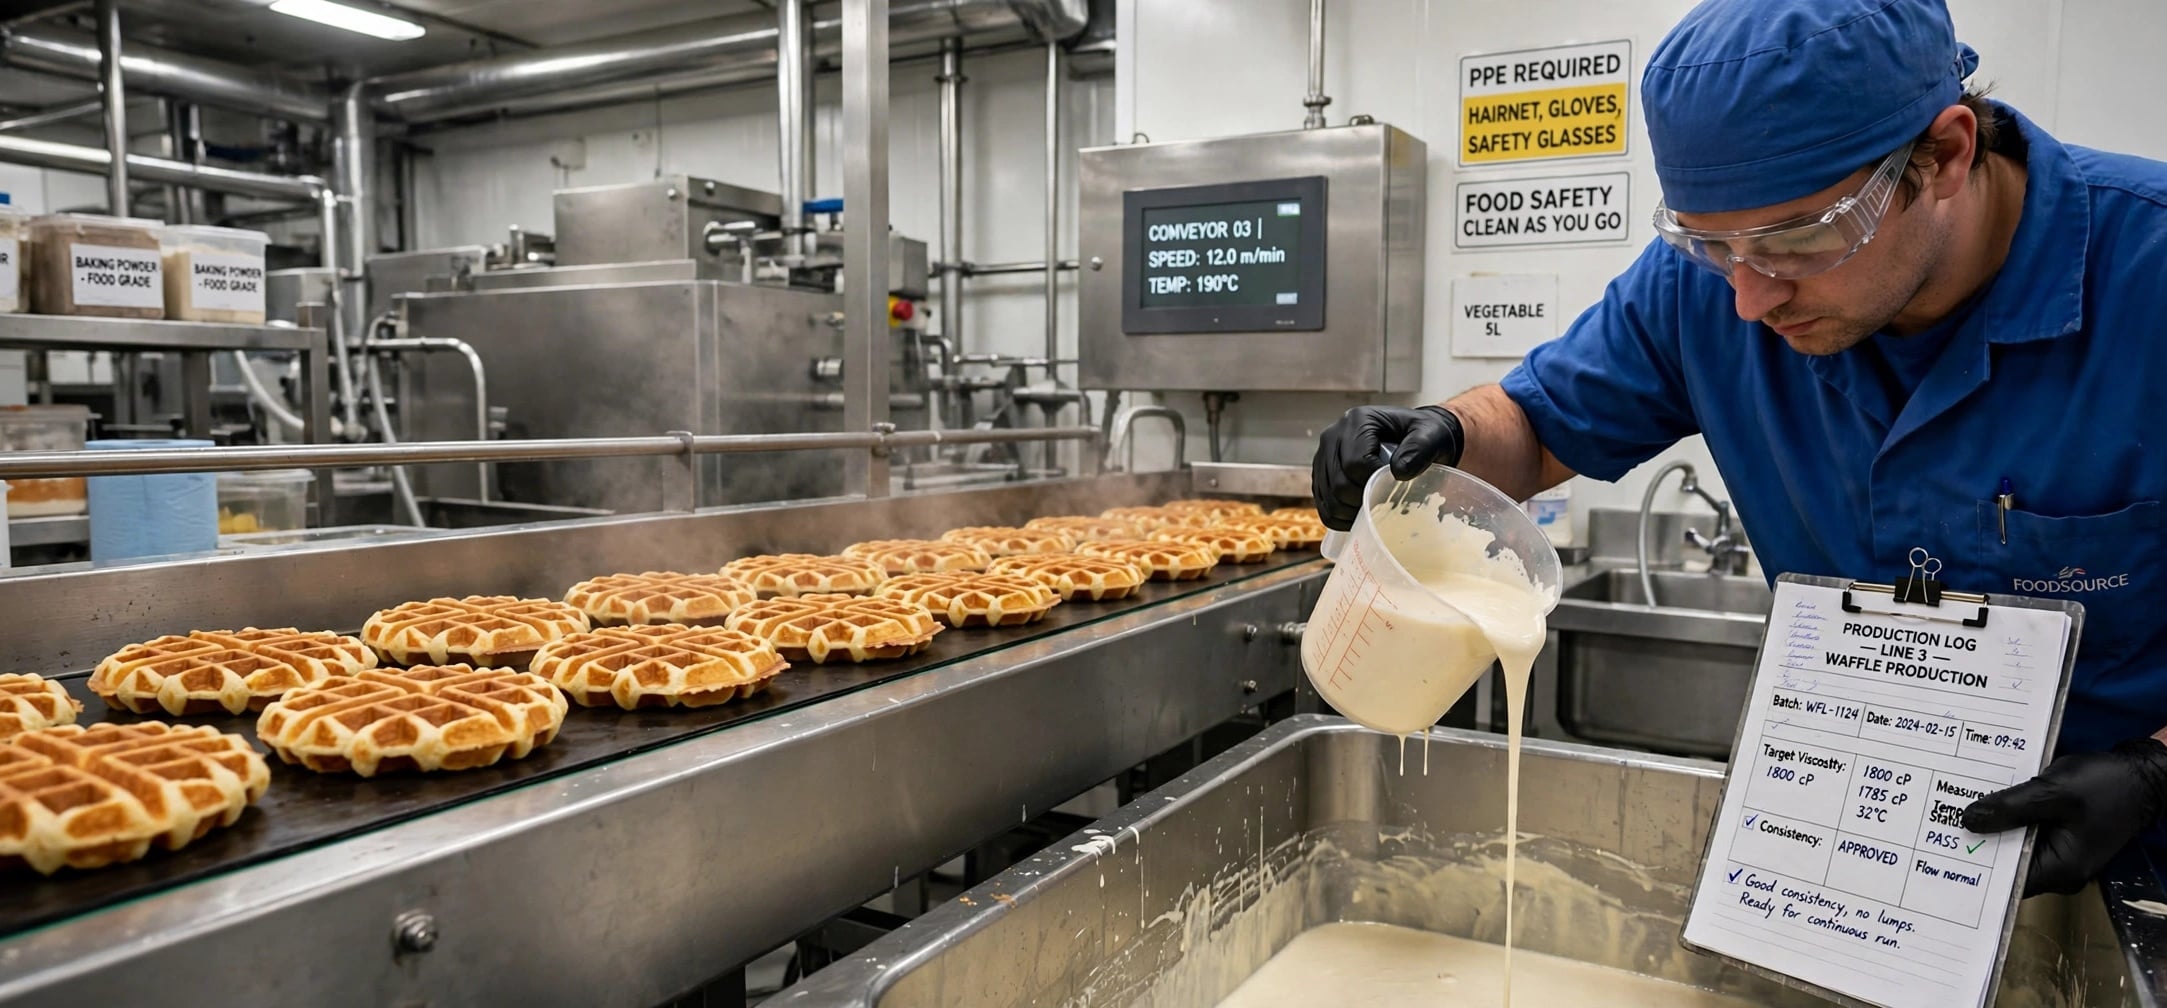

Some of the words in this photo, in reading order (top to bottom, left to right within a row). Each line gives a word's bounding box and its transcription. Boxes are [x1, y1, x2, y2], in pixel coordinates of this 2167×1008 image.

[1469, 65, 1506, 88] PPE
[1514, 54, 1621, 82] REQUIRED
[1468, 101, 1543, 125] HAIRNET,
[1549, 94, 1622, 119] GLOVES,
[1468, 131, 1532, 154] SAFETY
[1537, 125, 1616, 149] GLASSES
[1466, 192, 1524, 214] FOOD
[1530, 185, 1613, 210] SAFETY
[1149, 221, 1228, 242] CONVEYOR
[1233, 220, 1251, 238] 03
[1464, 216, 1519, 236] CLEAN
[1524, 215, 1547, 234] AS
[1552, 213, 1589, 232] YOU
[1595, 212, 1621, 230] GO
[76, 256, 115, 271] BAKING
[117, 258, 158, 273] POWDER
[1149, 250, 1200, 268] SPEED:
[1206, 248, 1236, 265] 12.0
[1240, 246, 1285, 264] m/min
[88, 272, 115, 286] FOOD
[118, 274, 152, 288] GRADE
[195, 263, 227, 277] BAKING
[204, 278, 227, 290] FOOD
[1149, 276, 1191, 294] TEMP:
[1197, 274, 1239, 293] 190°C
[1464, 304, 1544, 319] VEGETABLE
[1485, 322, 1501, 336] 5L
[2013, 573, 2130, 593] FOODSOURCE
[1843, 622, 1941, 647] PRODUCTION
[1944, 635, 1977, 651] LOG
[1880, 644, 1914, 660] LINE
[1917, 649, 1927, 662] 3
[1825, 651, 1882, 672] WAFFLE
[1885, 661, 1988, 688] PRODUCTION
[1773, 694, 1802, 711] Batch:
[1805, 700, 1859, 720] WFL-1124
[1866, 711, 1893, 727] Date:
[1894, 717, 1957, 738] 2024-02-15
[1965, 729, 1992, 745] Time:
[1994, 734, 2026, 750] 09:42
[1764, 743, 1796, 762] Target
[1767, 765, 1795, 782] 1800
[1798, 773, 1815, 786] cP
[1863, 765, 1893, 782] 1800
[1895, 773, 1912, 786] cP
[1858, 785, 1889, 802] 1785
[1891, 793, 1908, 806] cP
[1936, 780, 1994, 801] Measure
[1856, 805, 1888, 823] 32°C
[1760, 820, 1823, 848] Consistency:
[1926, 831, 1960, 850] PASS
[1838, 839, 1898, 866] APPROVED
[1915, 859, 1940, 876] Flow
[1943, 870, 1982, 887] normal
[1745, 873, 1777, 893] Good
[1781, 887, 1848, 918] consistency,
[1856, 908, 1870, 919] no
[1878, 909, 1916, 934] lumps.
[1740, 891, 1776, 919] Ready
[1783, 903, 1801, 919] for
[1807, 915, 1868, 940] continuous
[1875, 935, 1901, 950] run.
